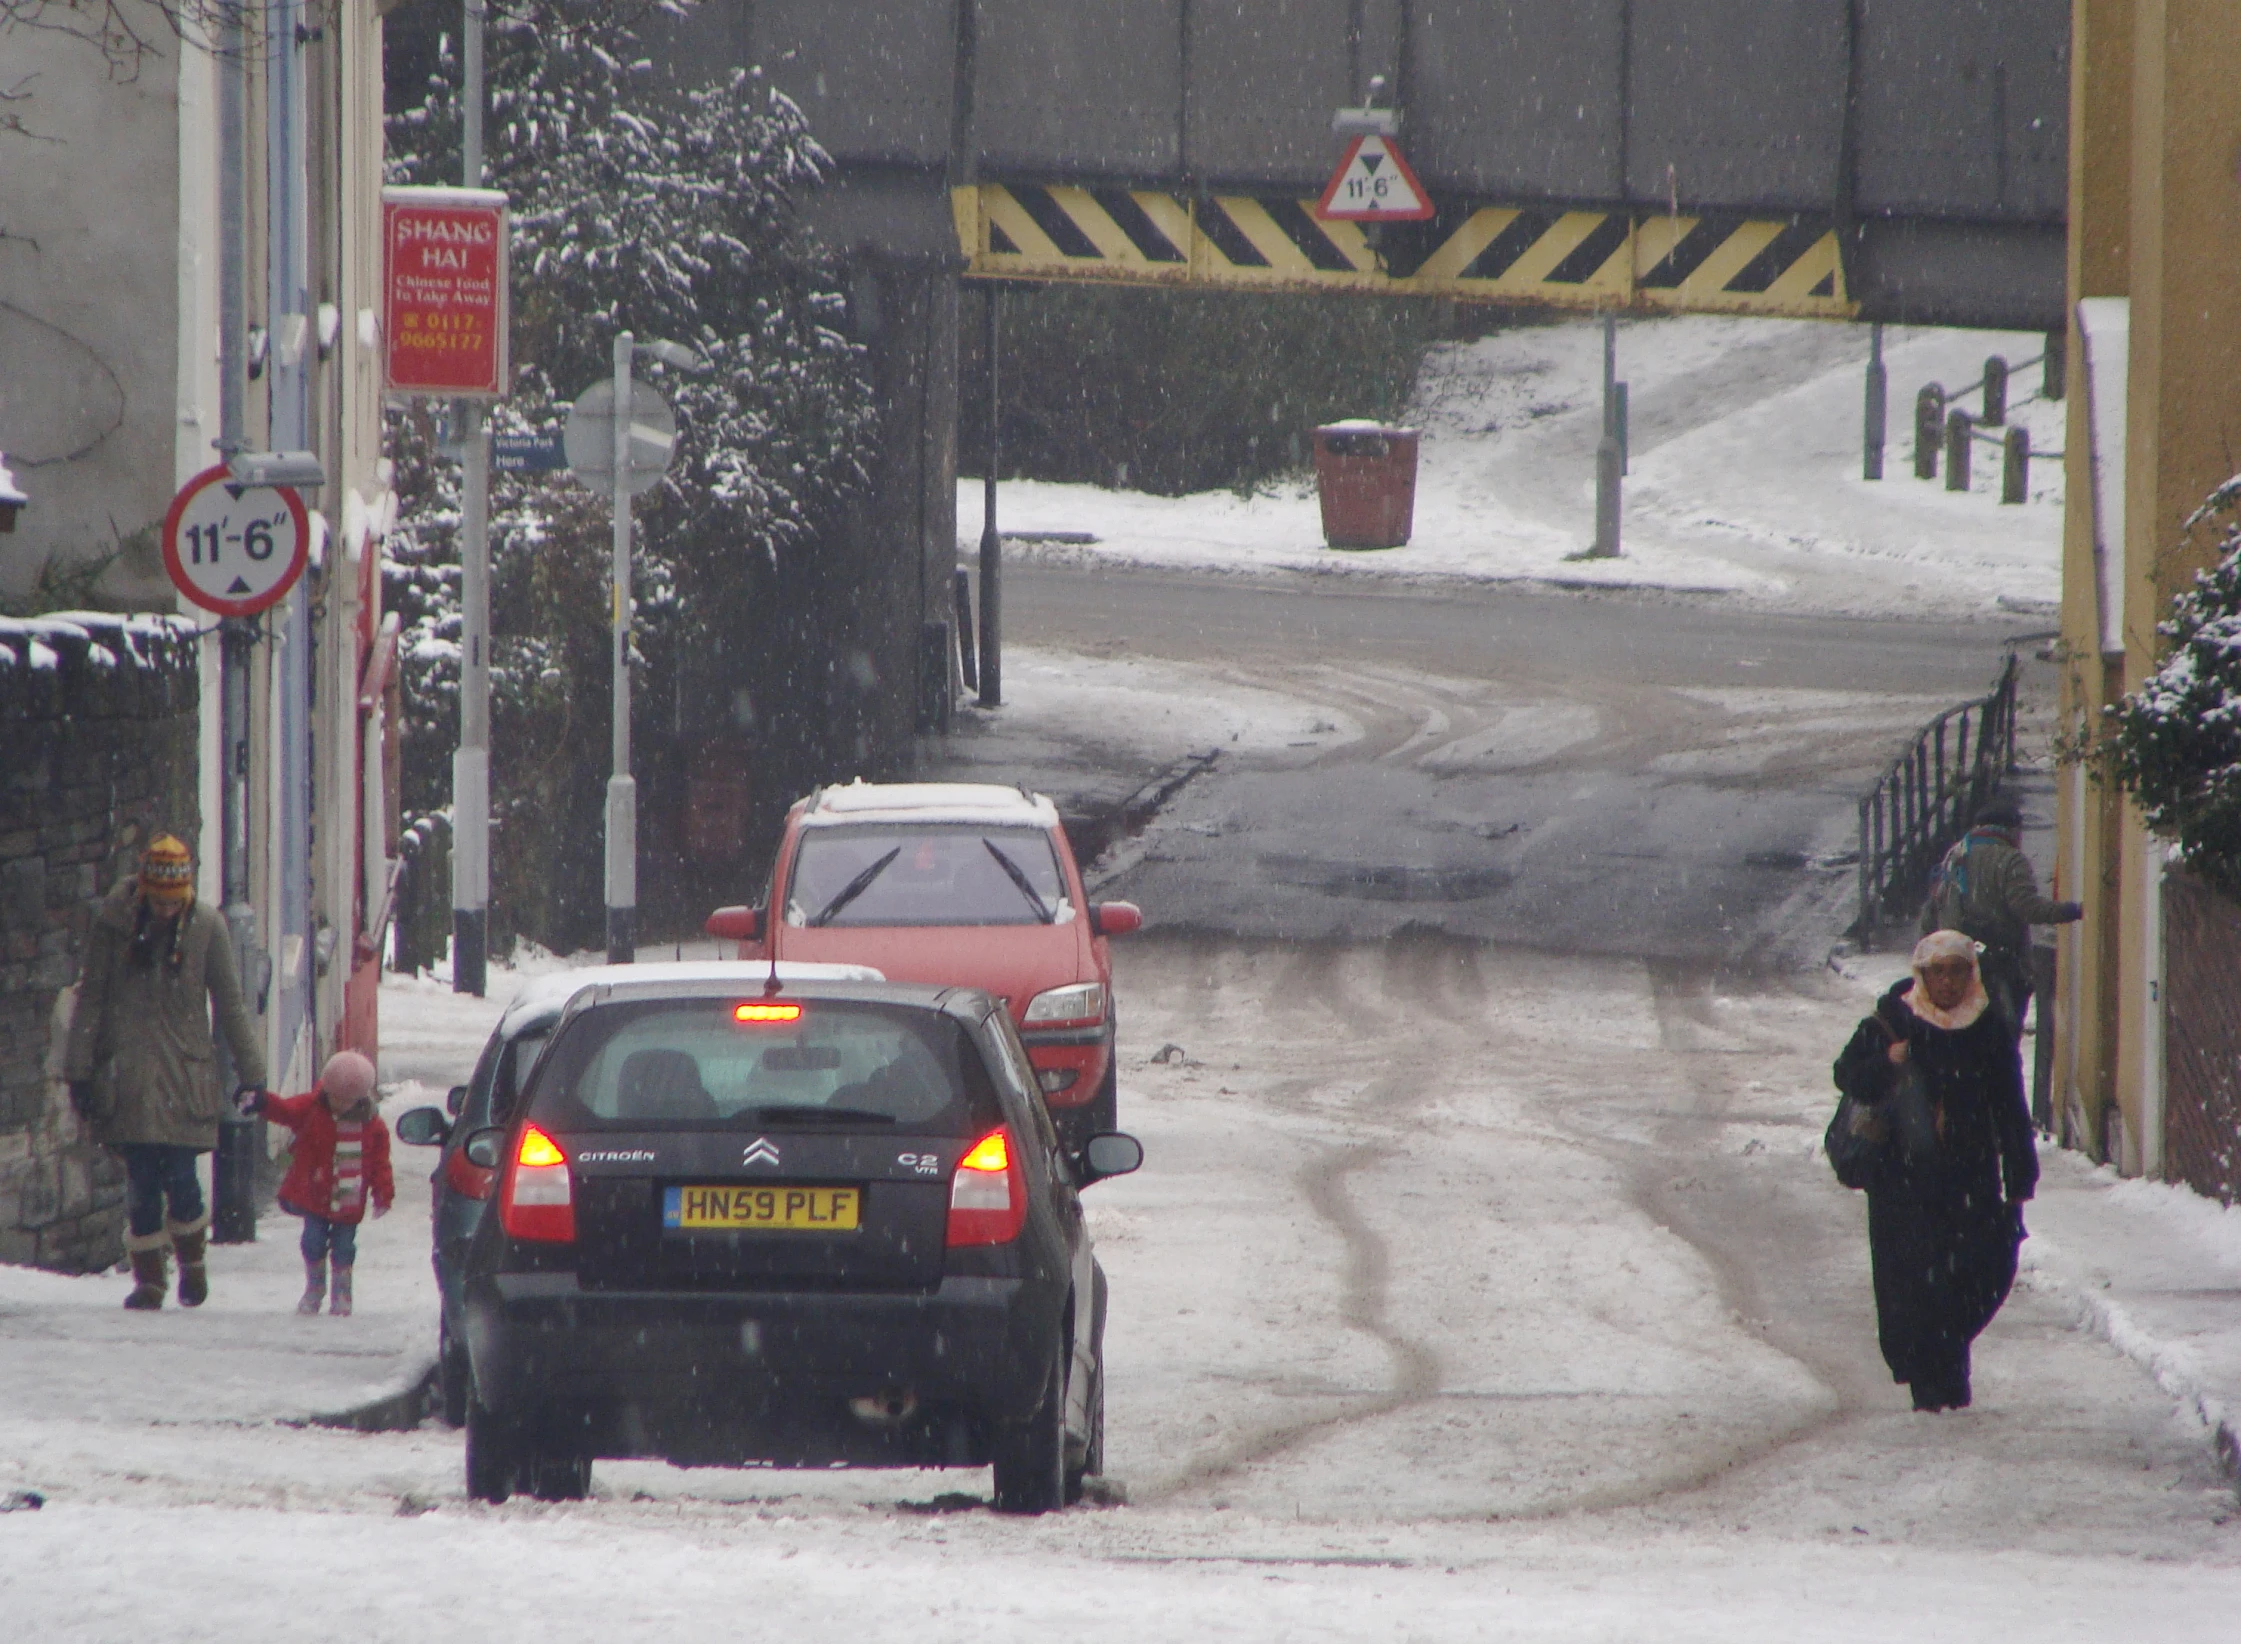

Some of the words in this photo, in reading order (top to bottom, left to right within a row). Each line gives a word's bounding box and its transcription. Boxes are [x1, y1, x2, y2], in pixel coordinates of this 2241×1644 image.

[397, 219, 491, 244] SHANG
[422, 247, 467, 269] HAI
[396, 275, 451, 289] Chinese
[456, 278, 489, 289] Food
[396, 289, 411, 302] To
[416, 289, 447, 303] Take
[453, 290, 489, 306] Away
[578, 1149, 656, 1161] CITROËN
[915, 1165, 938, 1175] VTR
[687, 1190, 775, 1221] HN59
[785, 1191, 852, 1222] PLF
